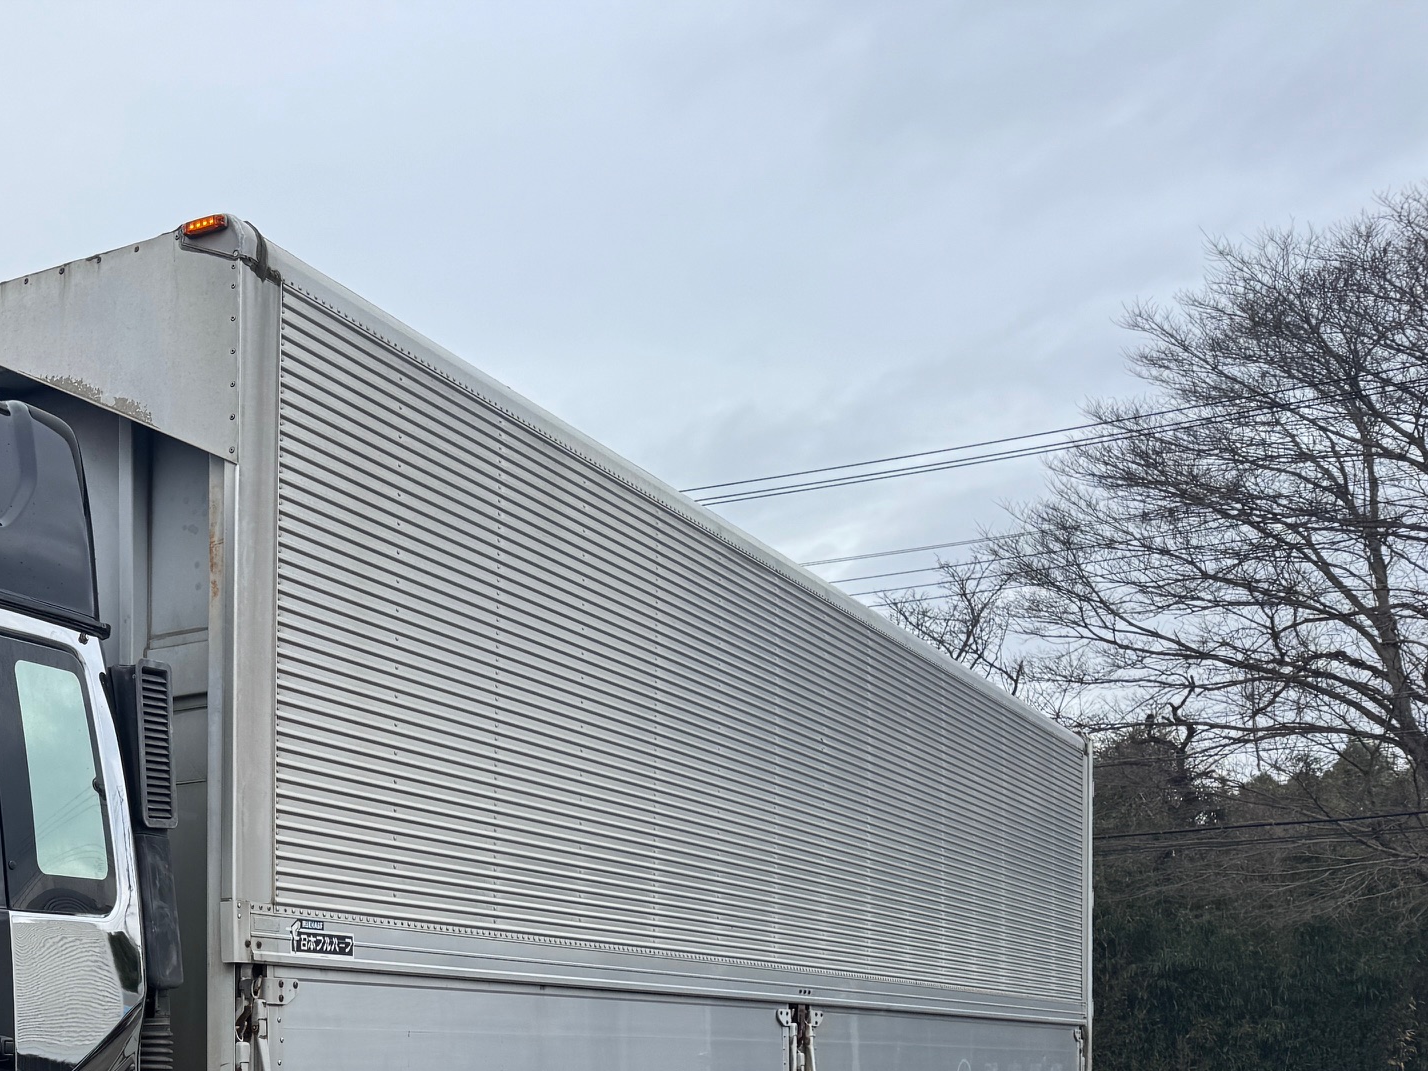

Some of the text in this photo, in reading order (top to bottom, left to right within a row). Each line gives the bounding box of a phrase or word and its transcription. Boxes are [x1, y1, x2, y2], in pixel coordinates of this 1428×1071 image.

[300, 934, 353, 952] 日本フルハーフ
